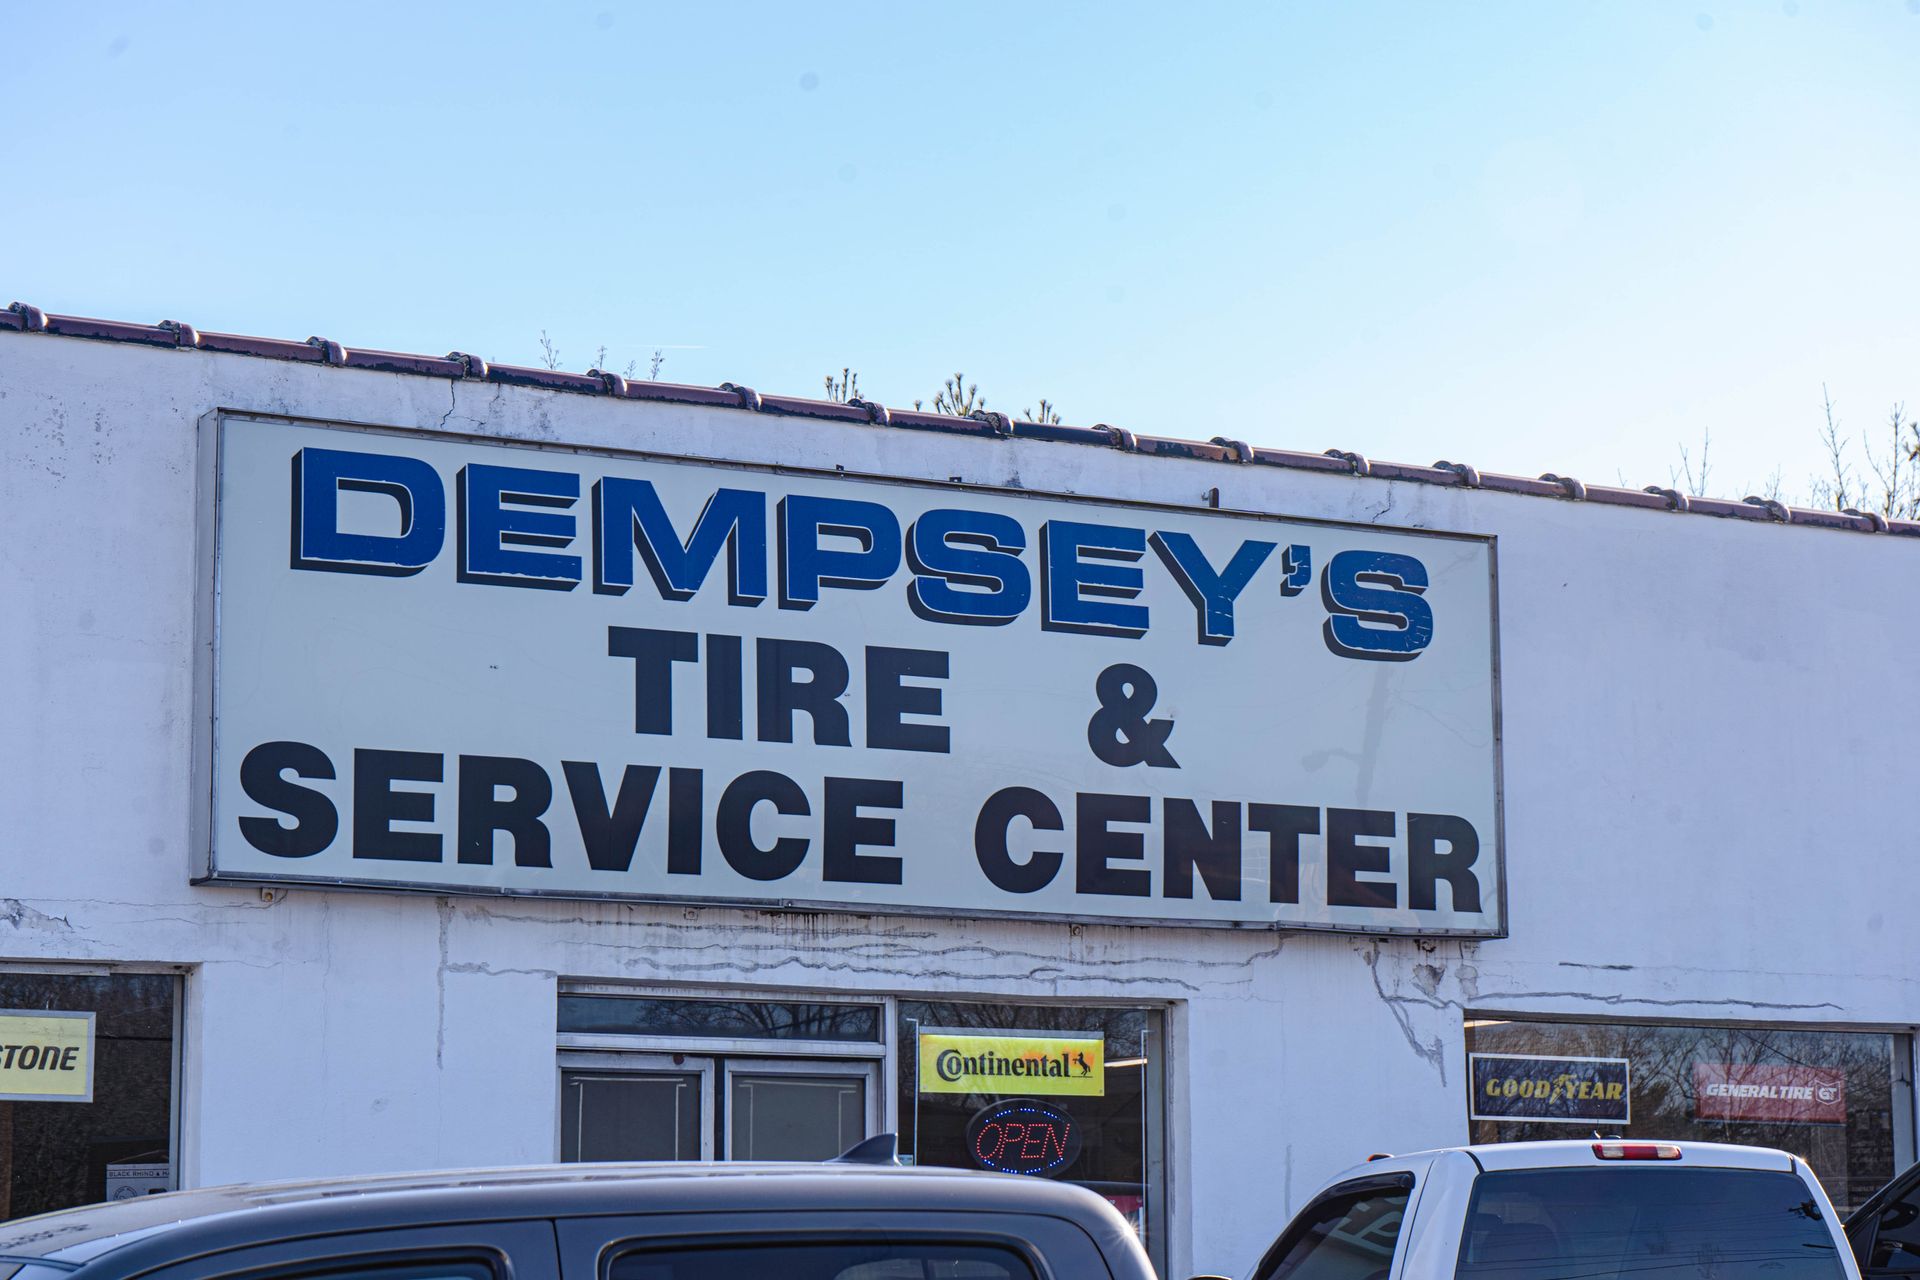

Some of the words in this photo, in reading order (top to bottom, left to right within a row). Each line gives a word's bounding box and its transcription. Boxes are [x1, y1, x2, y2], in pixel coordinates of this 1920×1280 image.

[290, 447, 1433, 661] DEMPSEY'S
[608, 625, 951, 754] TIRE
[1088, 663, 1181, 769] &
[238, 741, 903, 885] SERVICE
[975, 785, 1483, 913] CENTER
[0, 1045, 80, 1071] TONE
[936, 1049, 1071, 1082] Continental
[1706, 1083, 1778, 1099] GENERAL
[1779, 1086, 1814, 1100] TIRE
[977, 1123, 1071, 1159] OPEN
